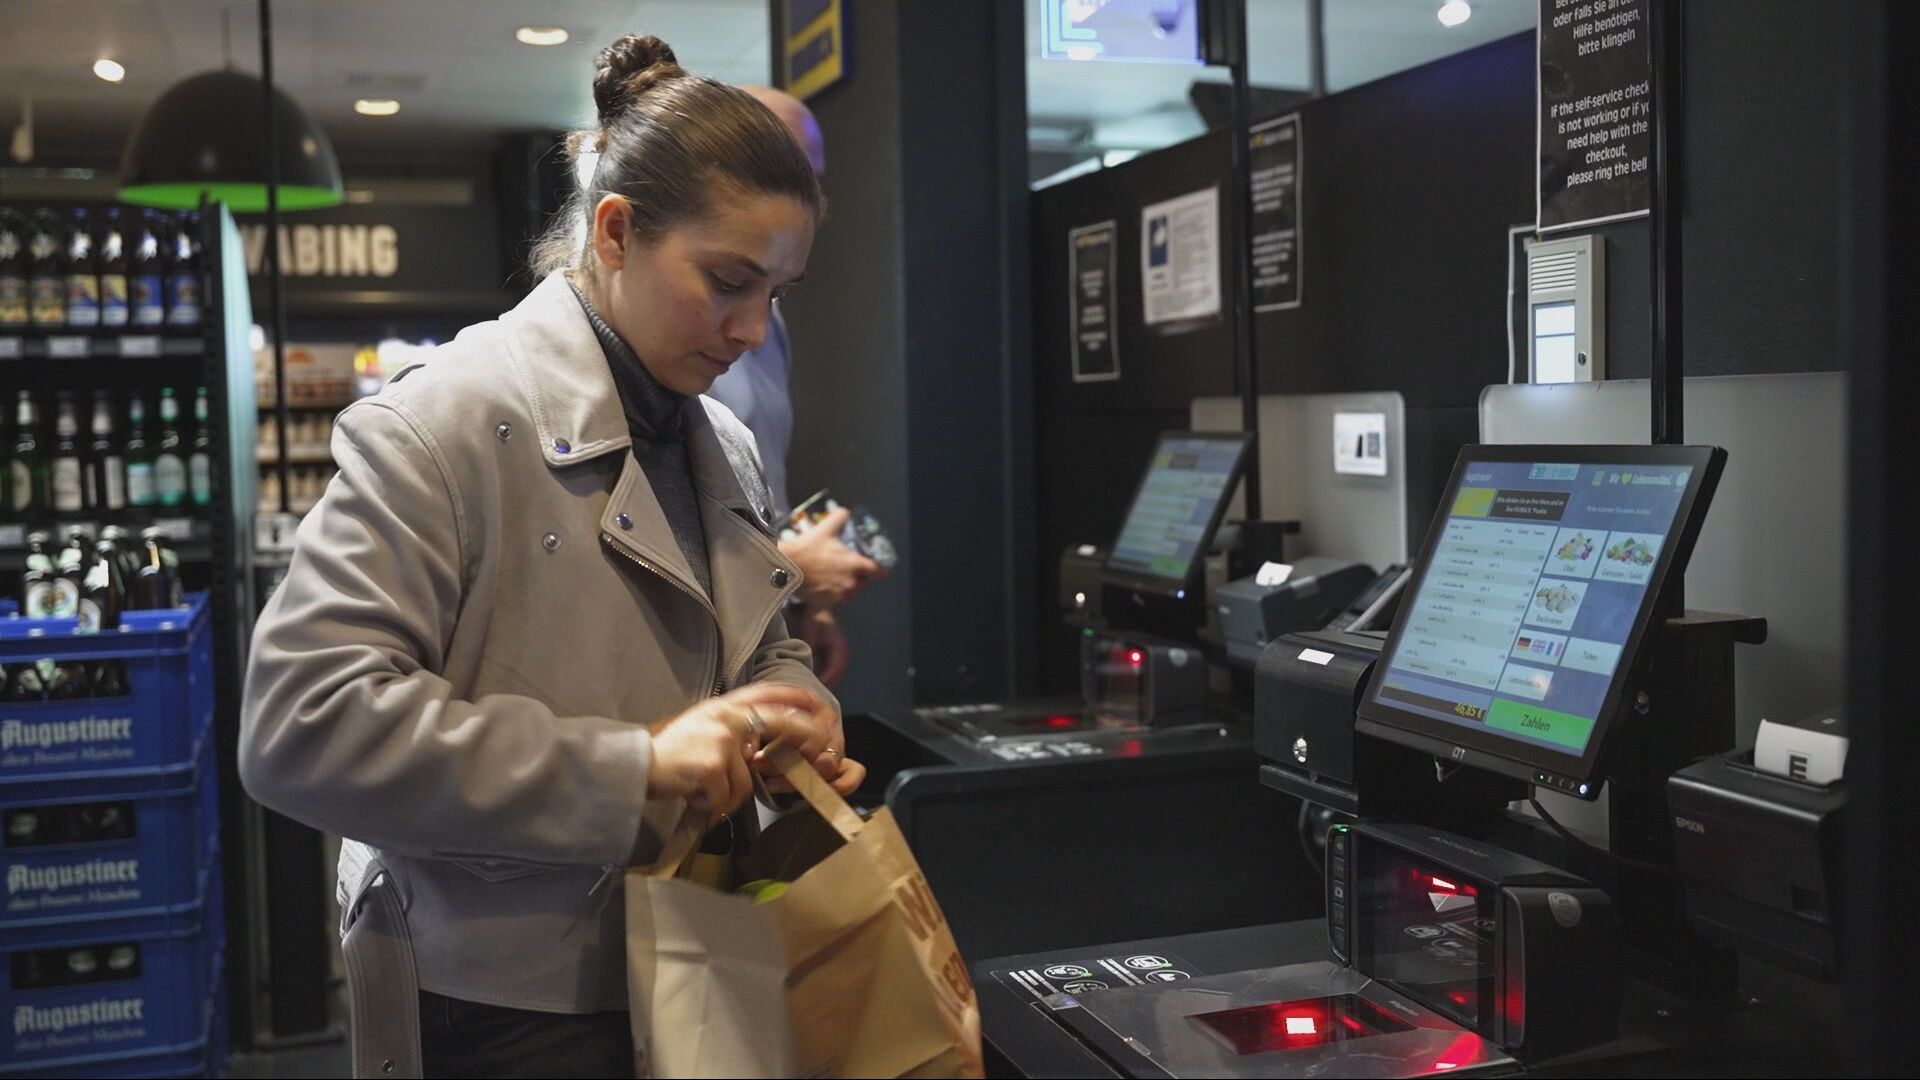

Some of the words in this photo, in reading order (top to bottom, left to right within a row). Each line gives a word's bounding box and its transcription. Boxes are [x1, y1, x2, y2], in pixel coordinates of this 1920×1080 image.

[1553, 11, 1573, 28] oder
[1574, 4, 1592, 20] falls
[1594, 0, 1607, 14] Sie
[1573, 23, 1593, 39] Hilfe
[1595, 8, 1640, 32] benötigen,
[1578, 40, 1600, 56] bitte
[1601, 28, 1636, 49] klingeln
[1550, 104, 1558, 118] If
[1559, 102, 1573, 116] the
[1575, 89, 1623, 112] self-service
[1558, 121, 1566, 134] is
[1566, 118, 1582, 132] not
[1583, 109, 1619, 128] working
[1620, 106, 1631, 119] or
[1632, 102, 1640, 116] if
[1567, 133, 1589, 150] need
[1589, 129, 1609, 145] help
[1610, 123, 1630, 140] with
[1632, 120, 1648, 134] the
[1585, 142, 1628, 164] checkout,
[1567, 170, 1593, 189] please
[1595, 166, 1613, 181] ring
[1614, 162, 1630, 176] the
[1631, 157, 1648, 173] bell
[1, 715, 132, 751] Augustiner
[1520, 714, 1550, 732] Zahlen
[1675, 816, 1705, 834] EPSON
[8, 859, 139, 895] Augustiner
[14, 998, 144, 1036] Augustiner
